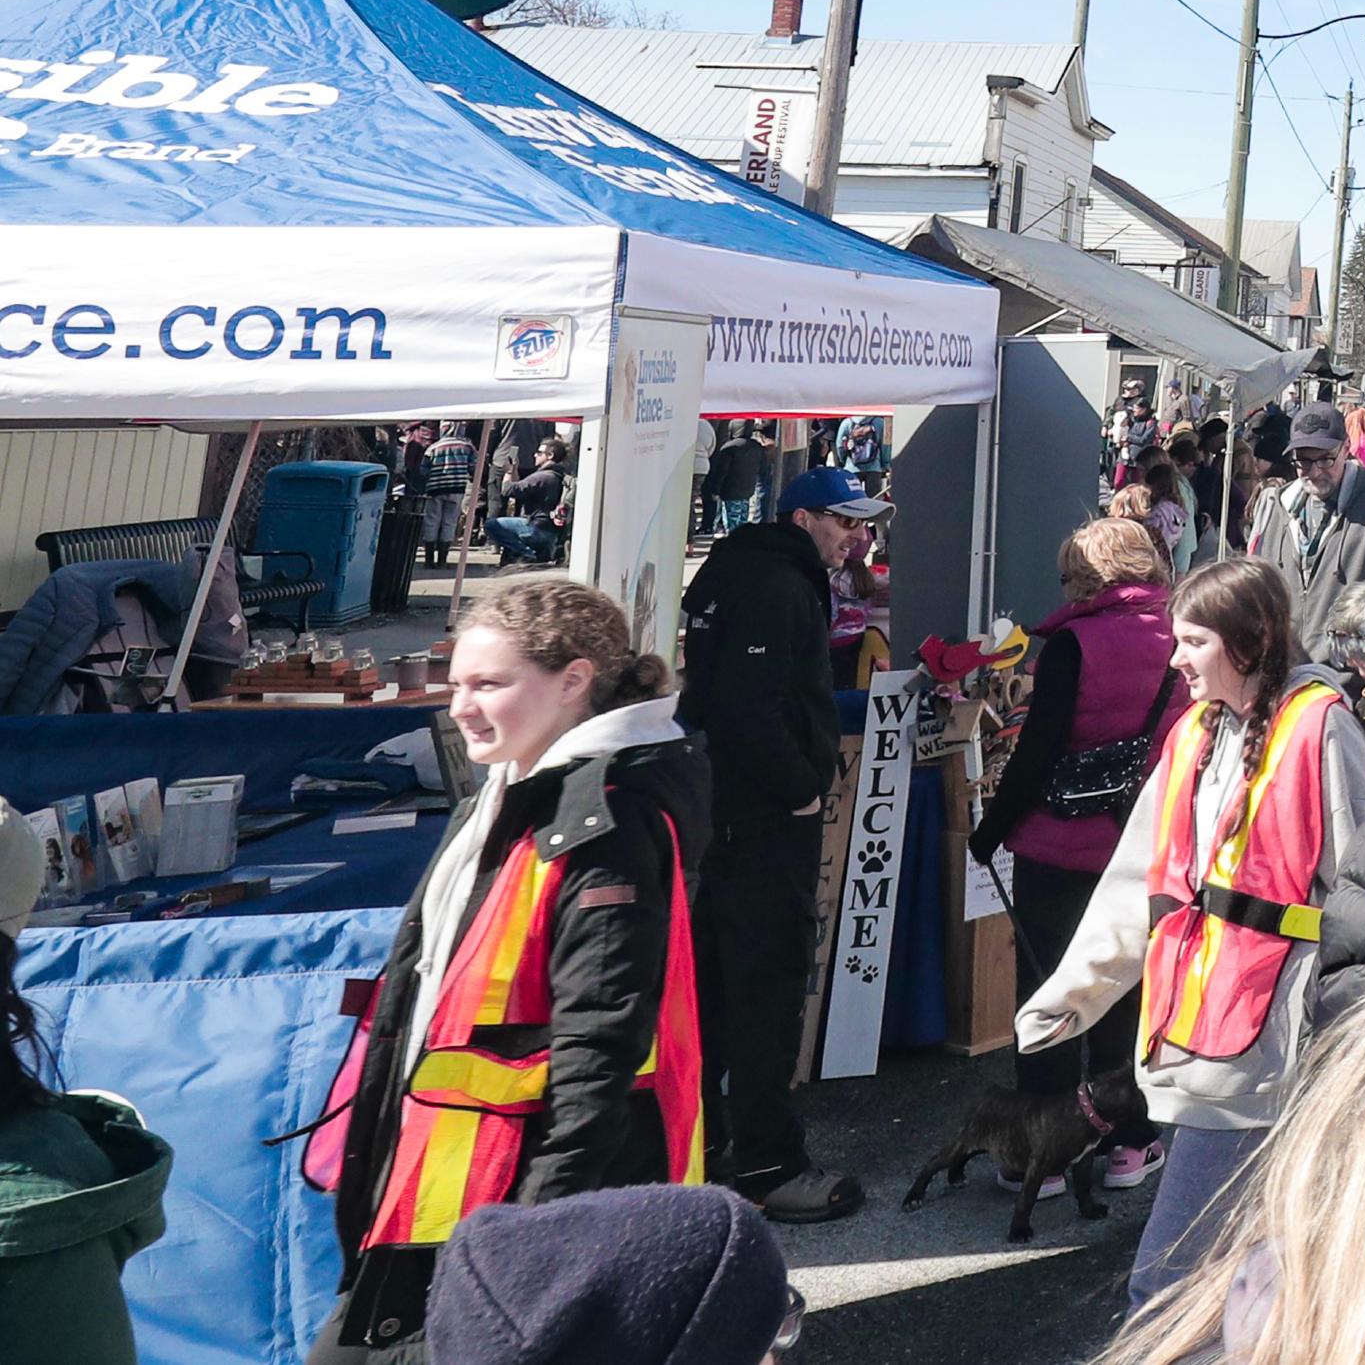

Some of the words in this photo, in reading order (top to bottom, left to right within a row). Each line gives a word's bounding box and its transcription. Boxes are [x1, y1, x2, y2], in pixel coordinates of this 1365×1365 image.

[30, 133, 256, 164] Brand
[770, 147, 784, 180] SYRUP
[777, 99, 792, 144] FESTIVAL
[0, 304, 391, 359] ce.com
[635, 389, 663, 423] Fence
[848, 695, 917, 949] WELCME
